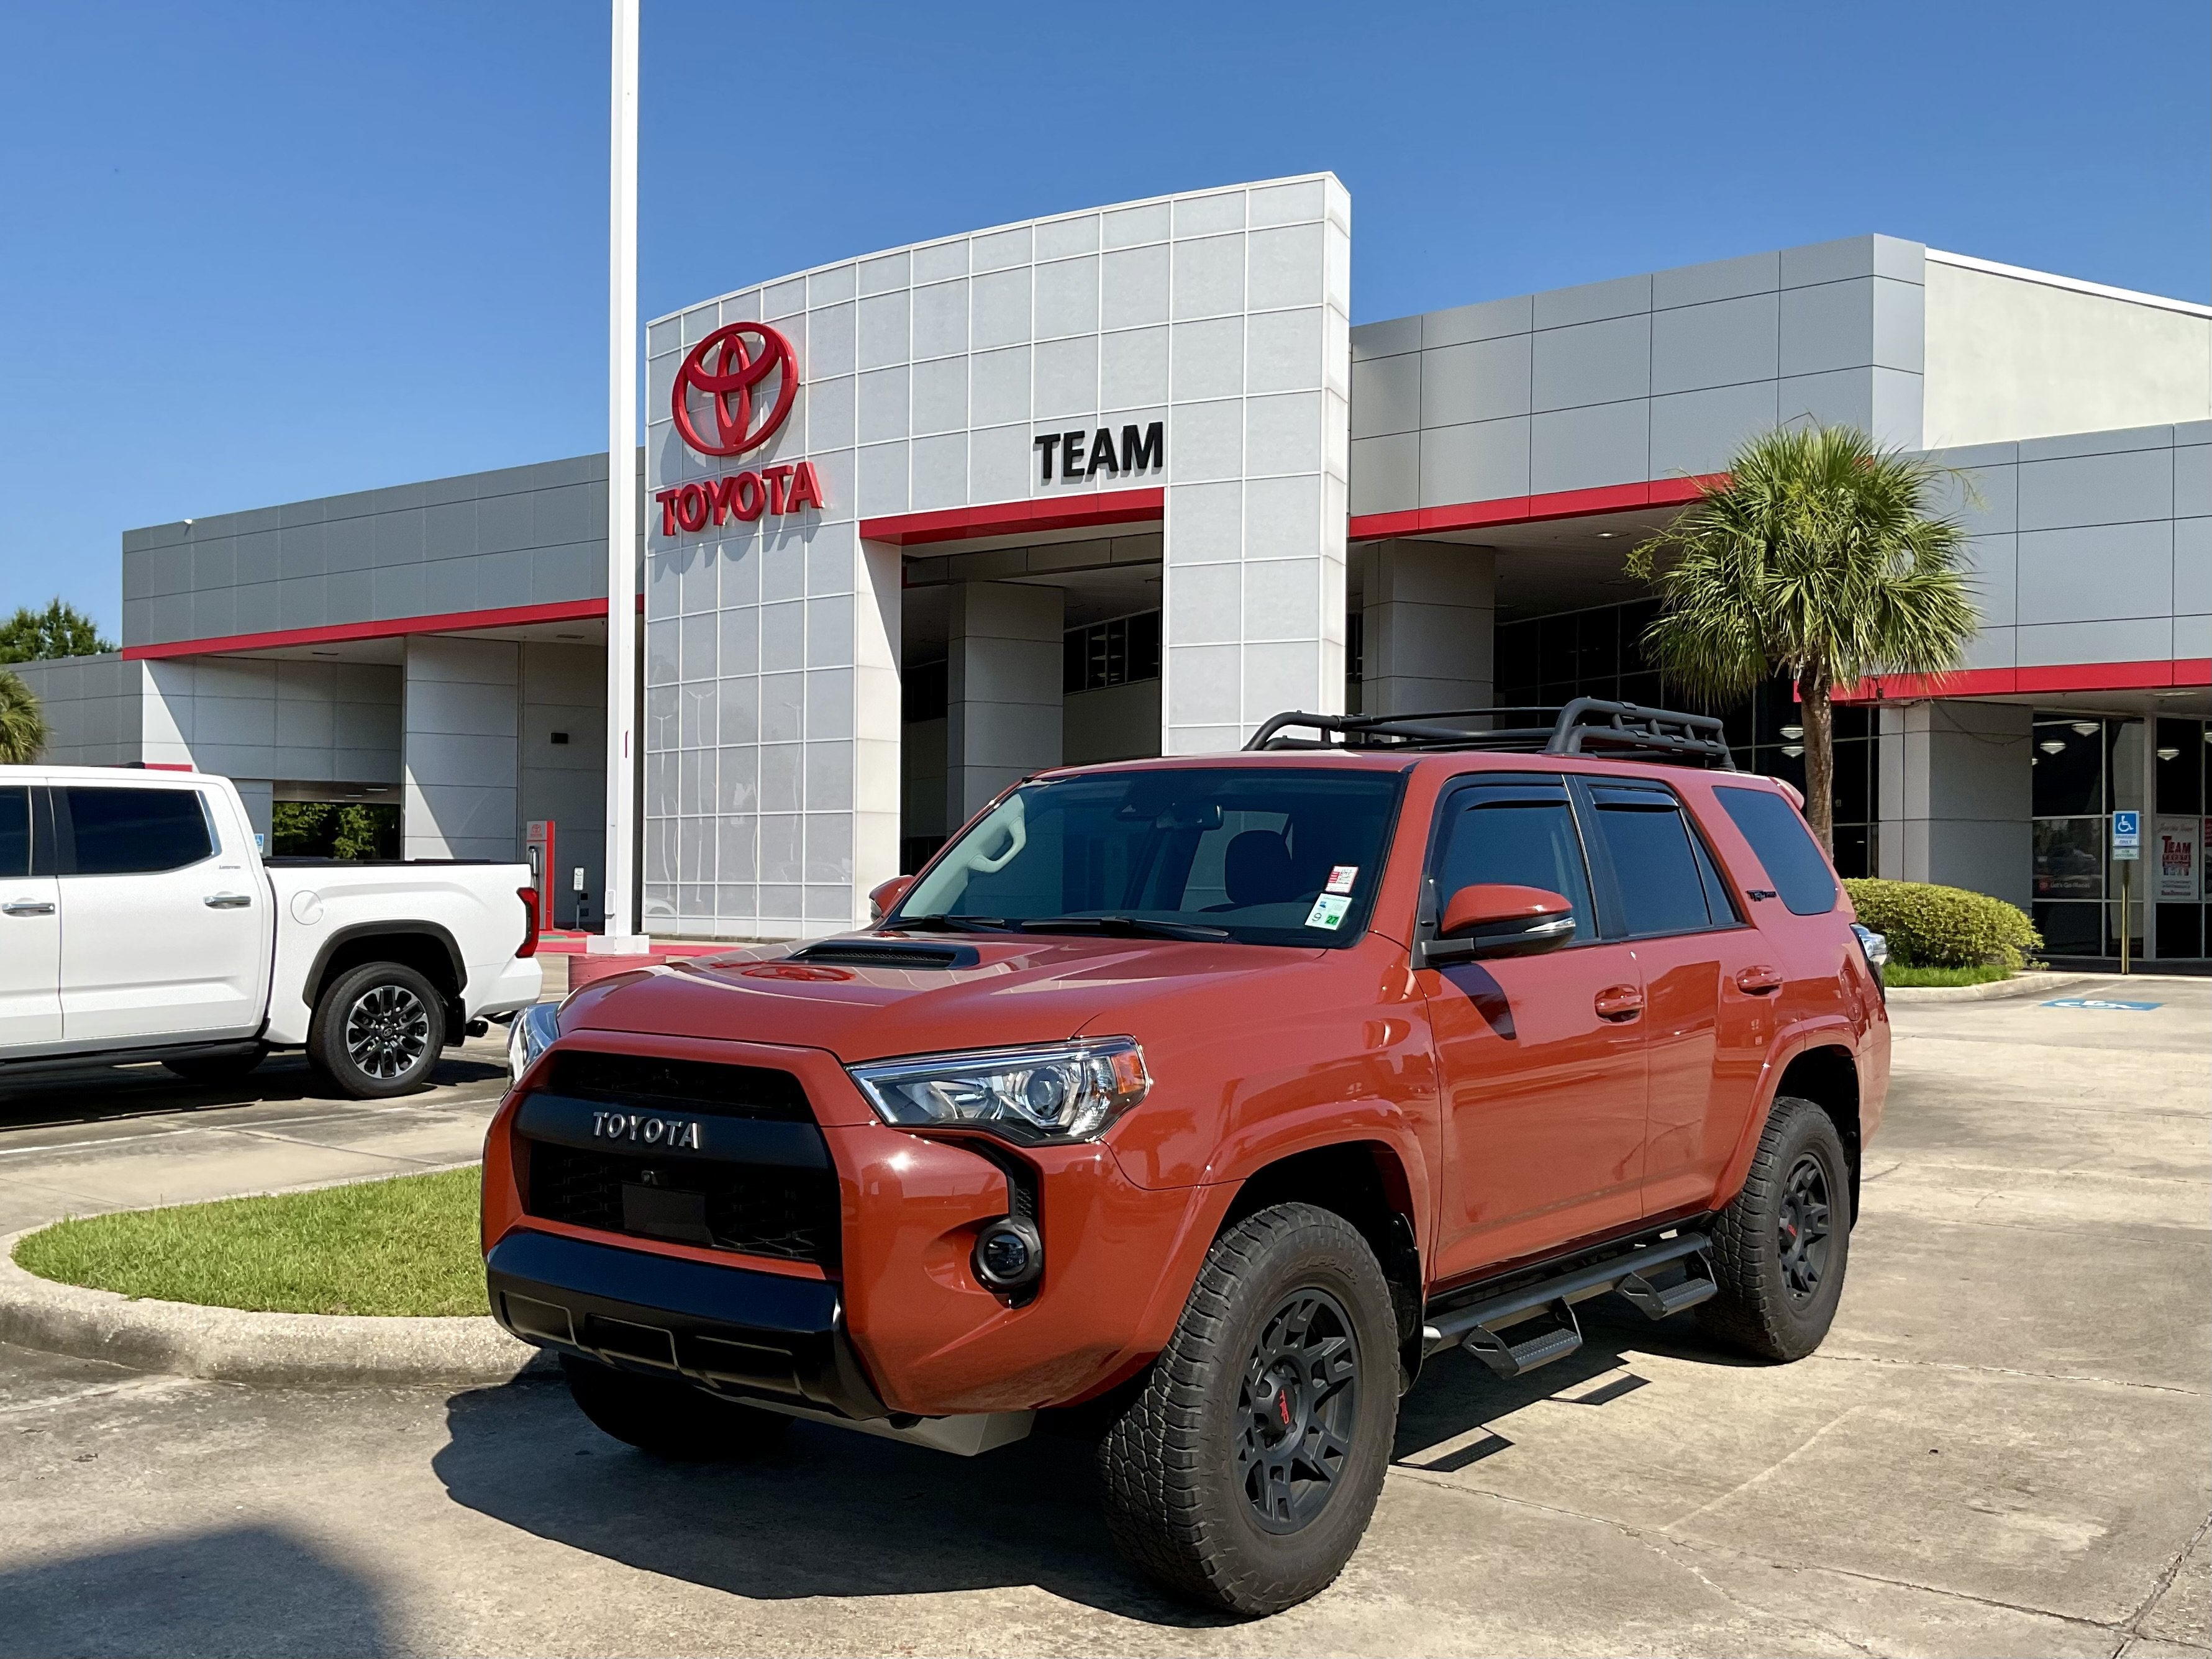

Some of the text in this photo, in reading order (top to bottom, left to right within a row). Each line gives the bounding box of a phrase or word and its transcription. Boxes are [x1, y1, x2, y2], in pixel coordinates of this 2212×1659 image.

[1034, 422, 1163, 480] TEAM
[656, 461, 826, 537] TOYOTA
[2162, 835, 2191, 853] TEAM
[1311, 912, 1339, 924] 9 27
[593, 1111, 699, 1149] TOYOTA
[1279, 1389, 1290, 1424] TRD
